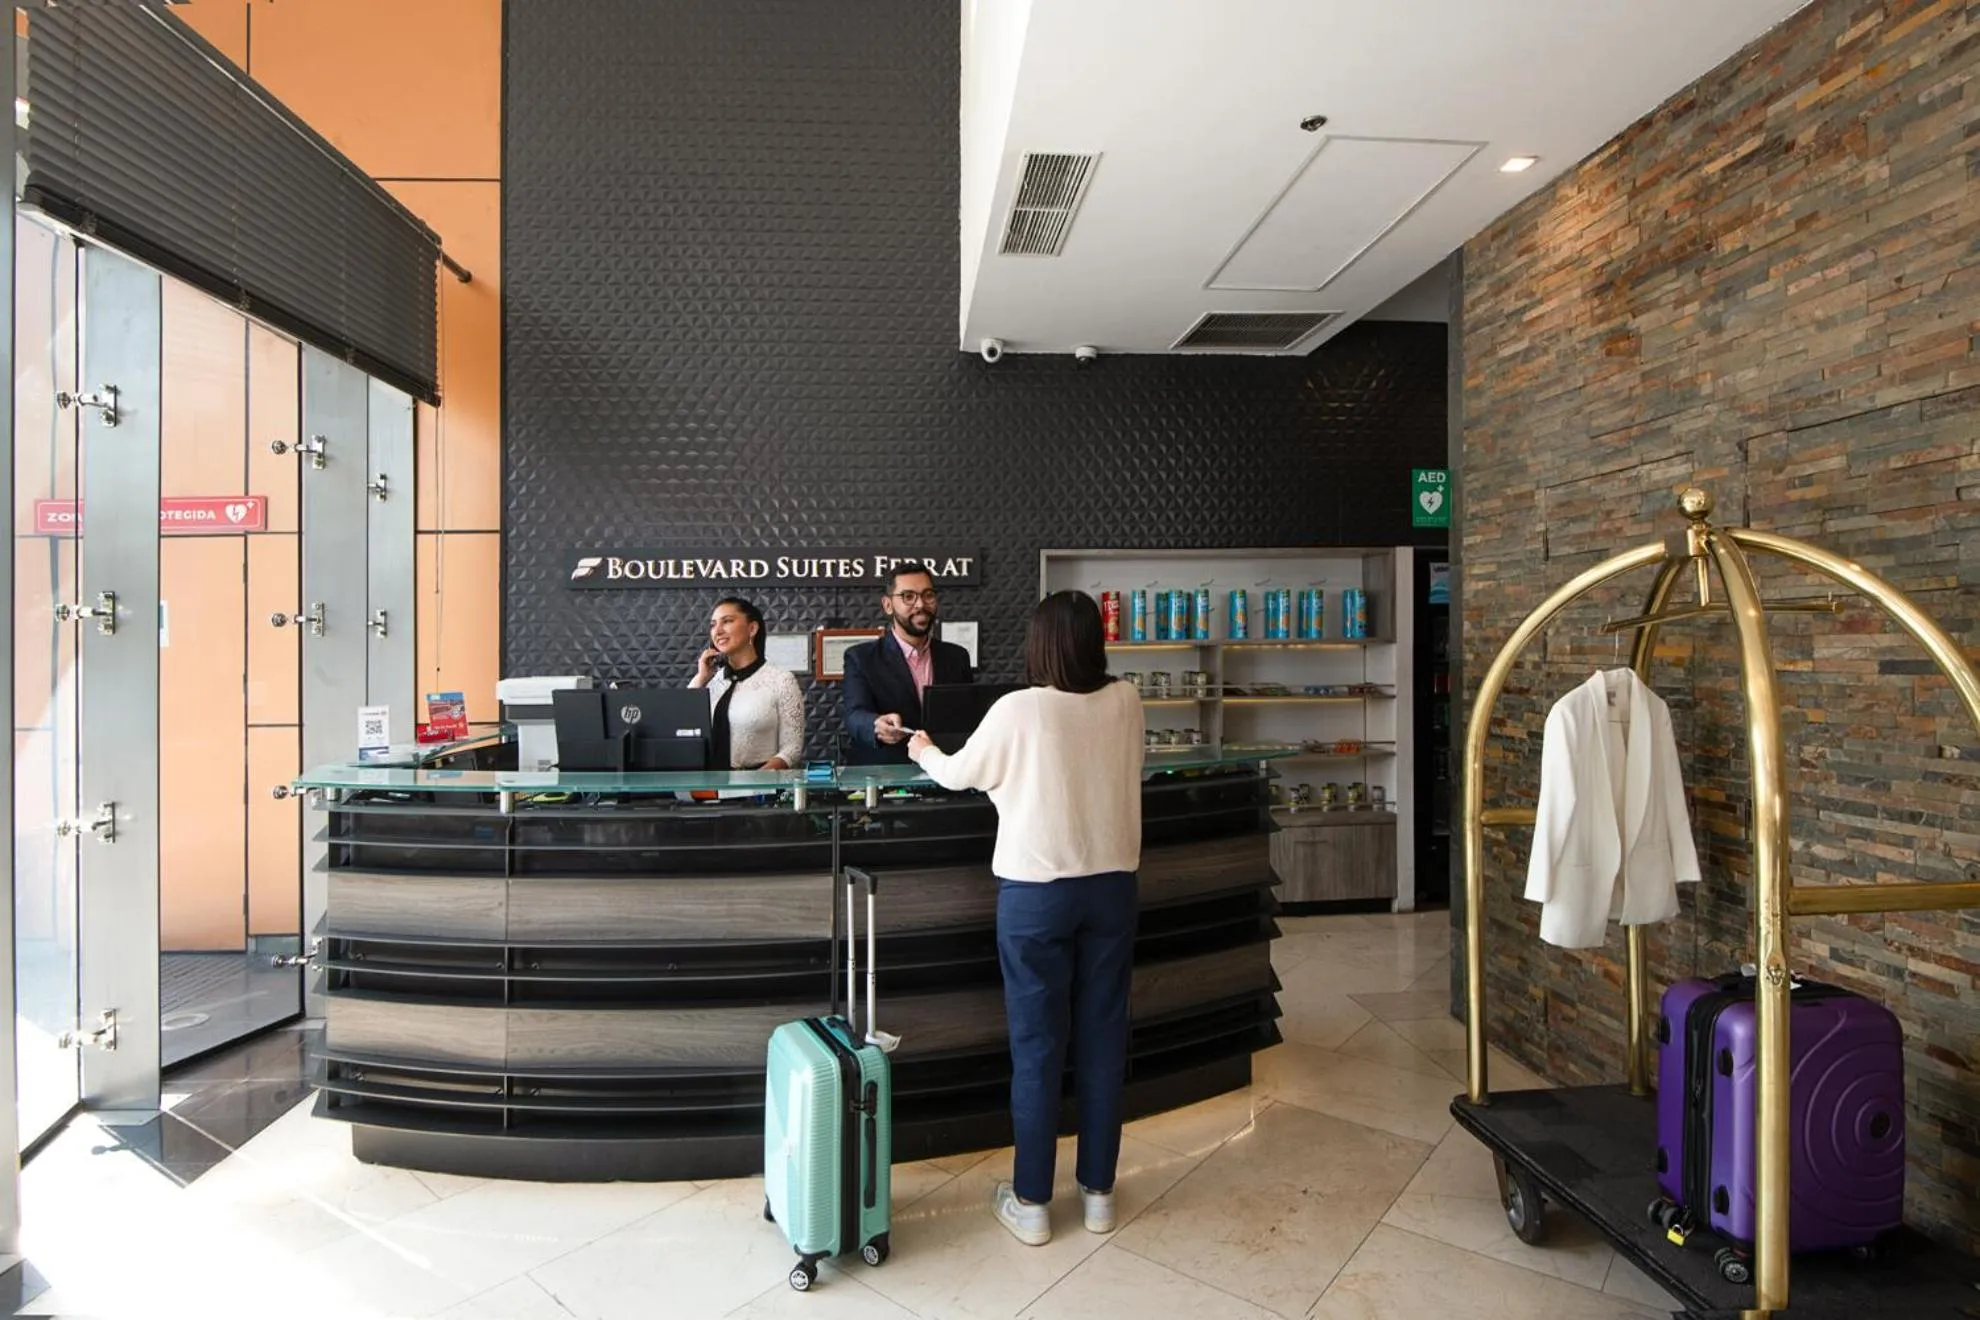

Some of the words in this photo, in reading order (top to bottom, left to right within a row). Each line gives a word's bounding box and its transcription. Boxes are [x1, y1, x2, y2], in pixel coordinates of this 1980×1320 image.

[1418, 471, 1446, 483] AED
[607, 556, 769, 579] BOULEVARD
[776, 556, 864, 578] SUITES
[874, 555, 973, 577] FRAT
[621, 705, 641, 724] hp
